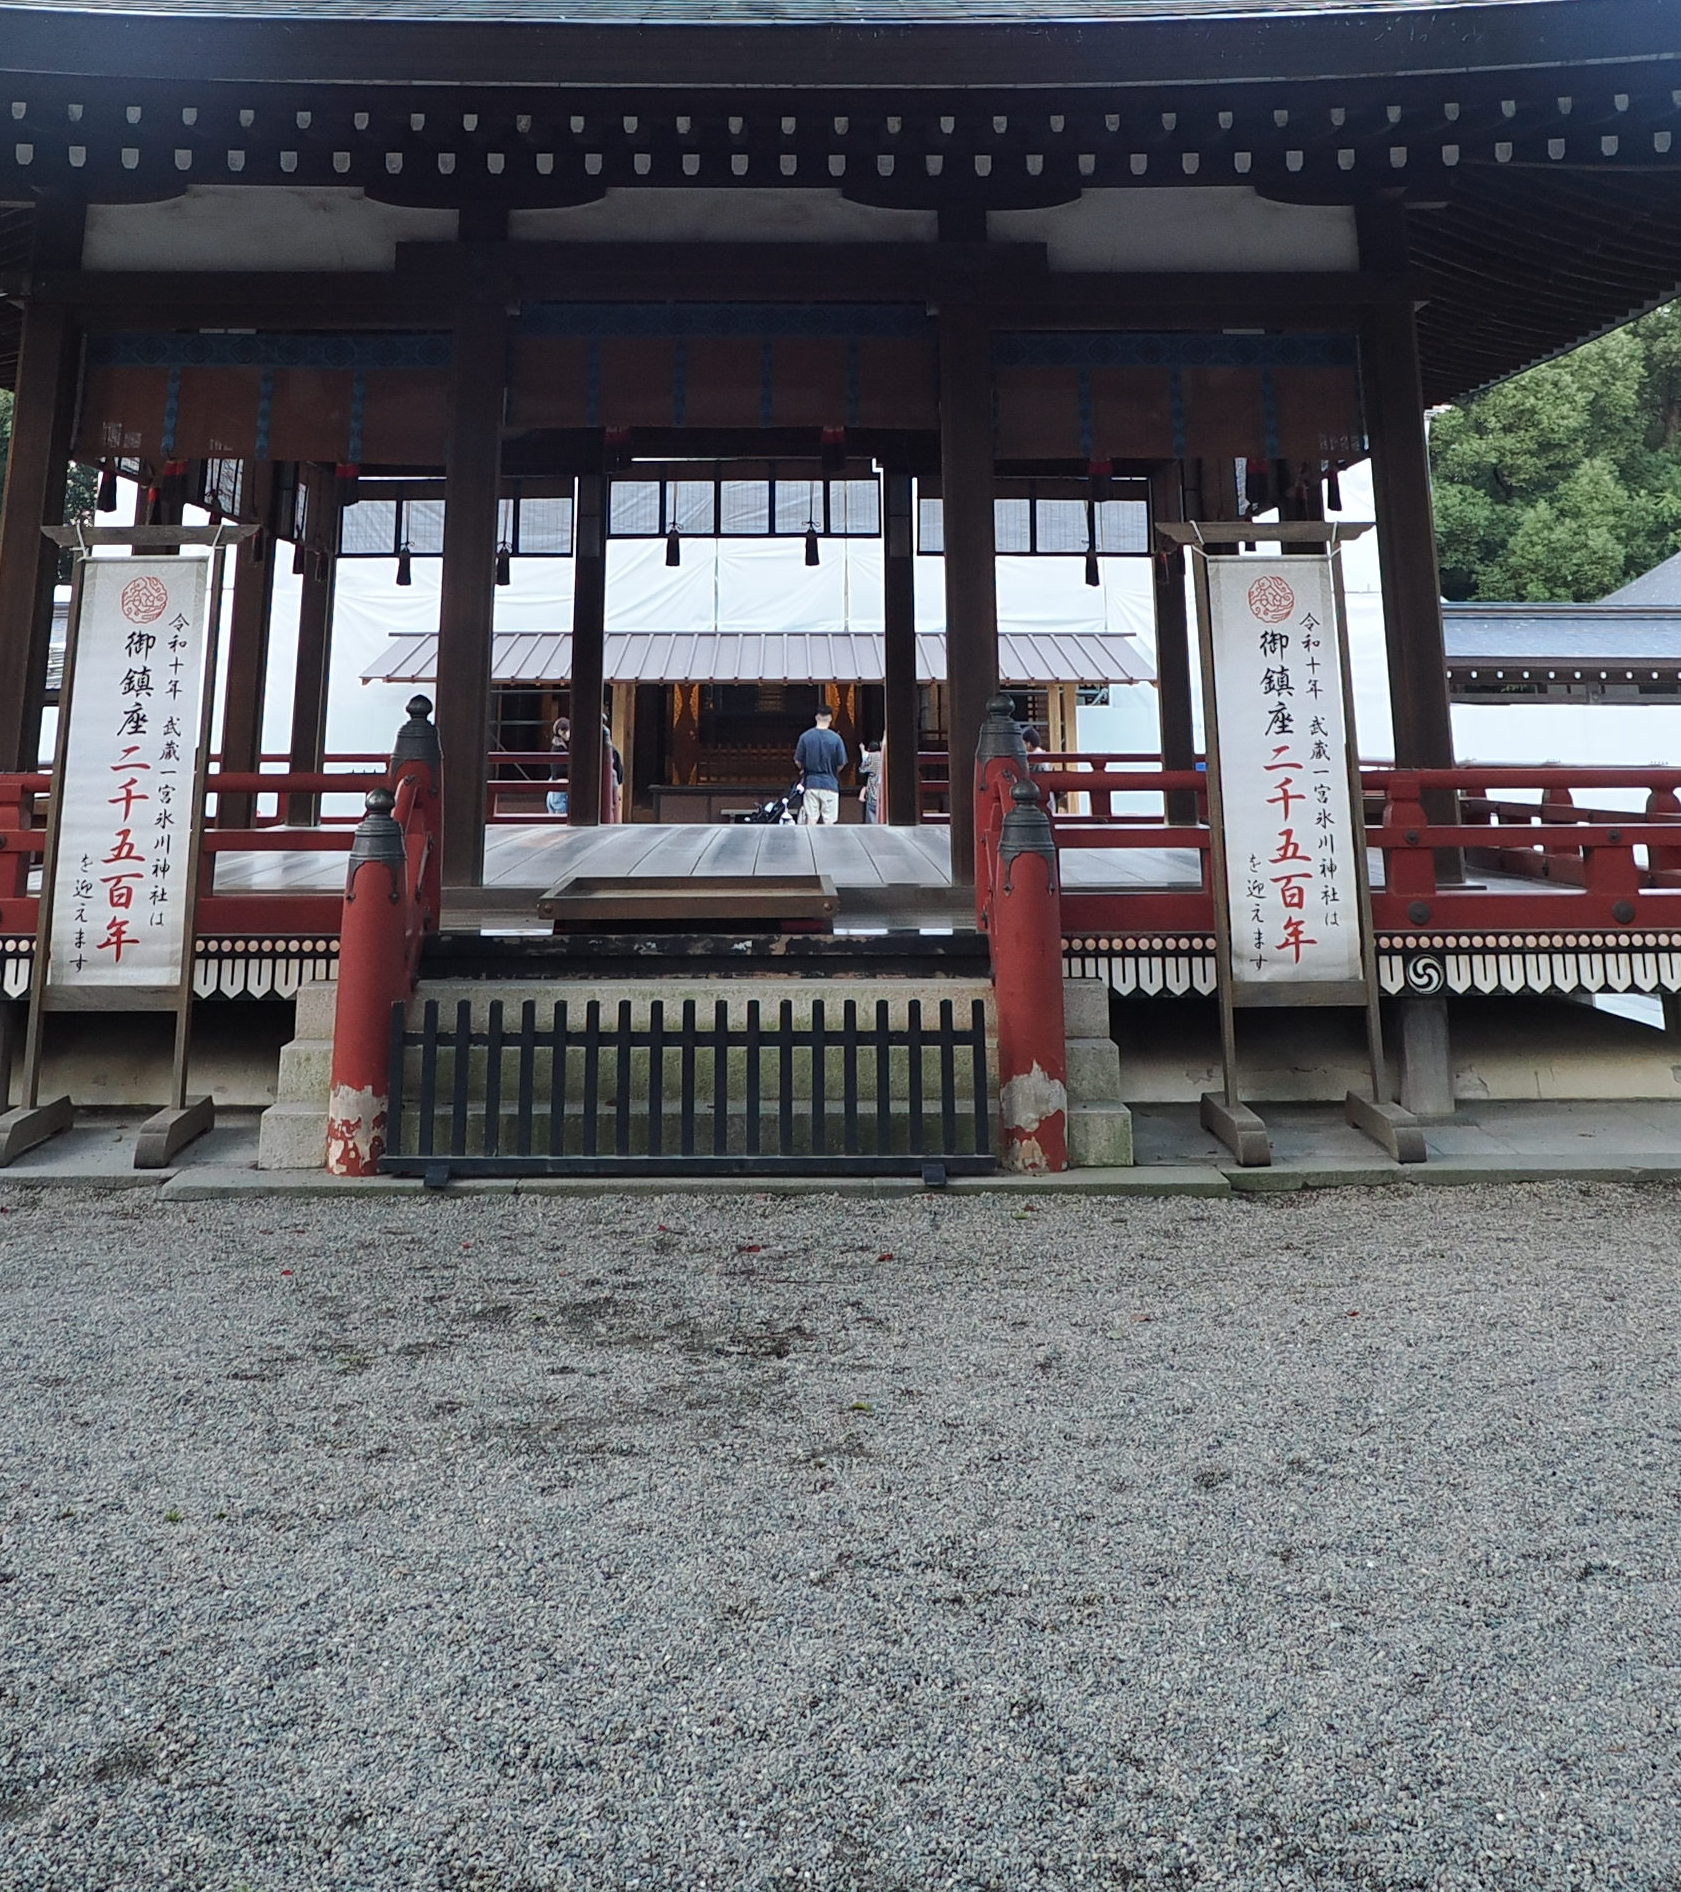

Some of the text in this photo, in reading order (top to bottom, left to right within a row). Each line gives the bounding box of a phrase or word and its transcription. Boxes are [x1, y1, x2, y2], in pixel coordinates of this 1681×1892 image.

[69, 853, 94, 974] を迎えます
[96, 630, 156, 963] 御鎮座二千五百年
[149, 613, 190, 927] 令和十年 武蔵一宮氷川神社は
[1246, 853, 1269, 971] を迎えます
[1259, 630, 1318, 965] 御鎮座二千五百年
[1299, 612, 1340, 926] 令和十年 武蔵一宮氷川神社は
